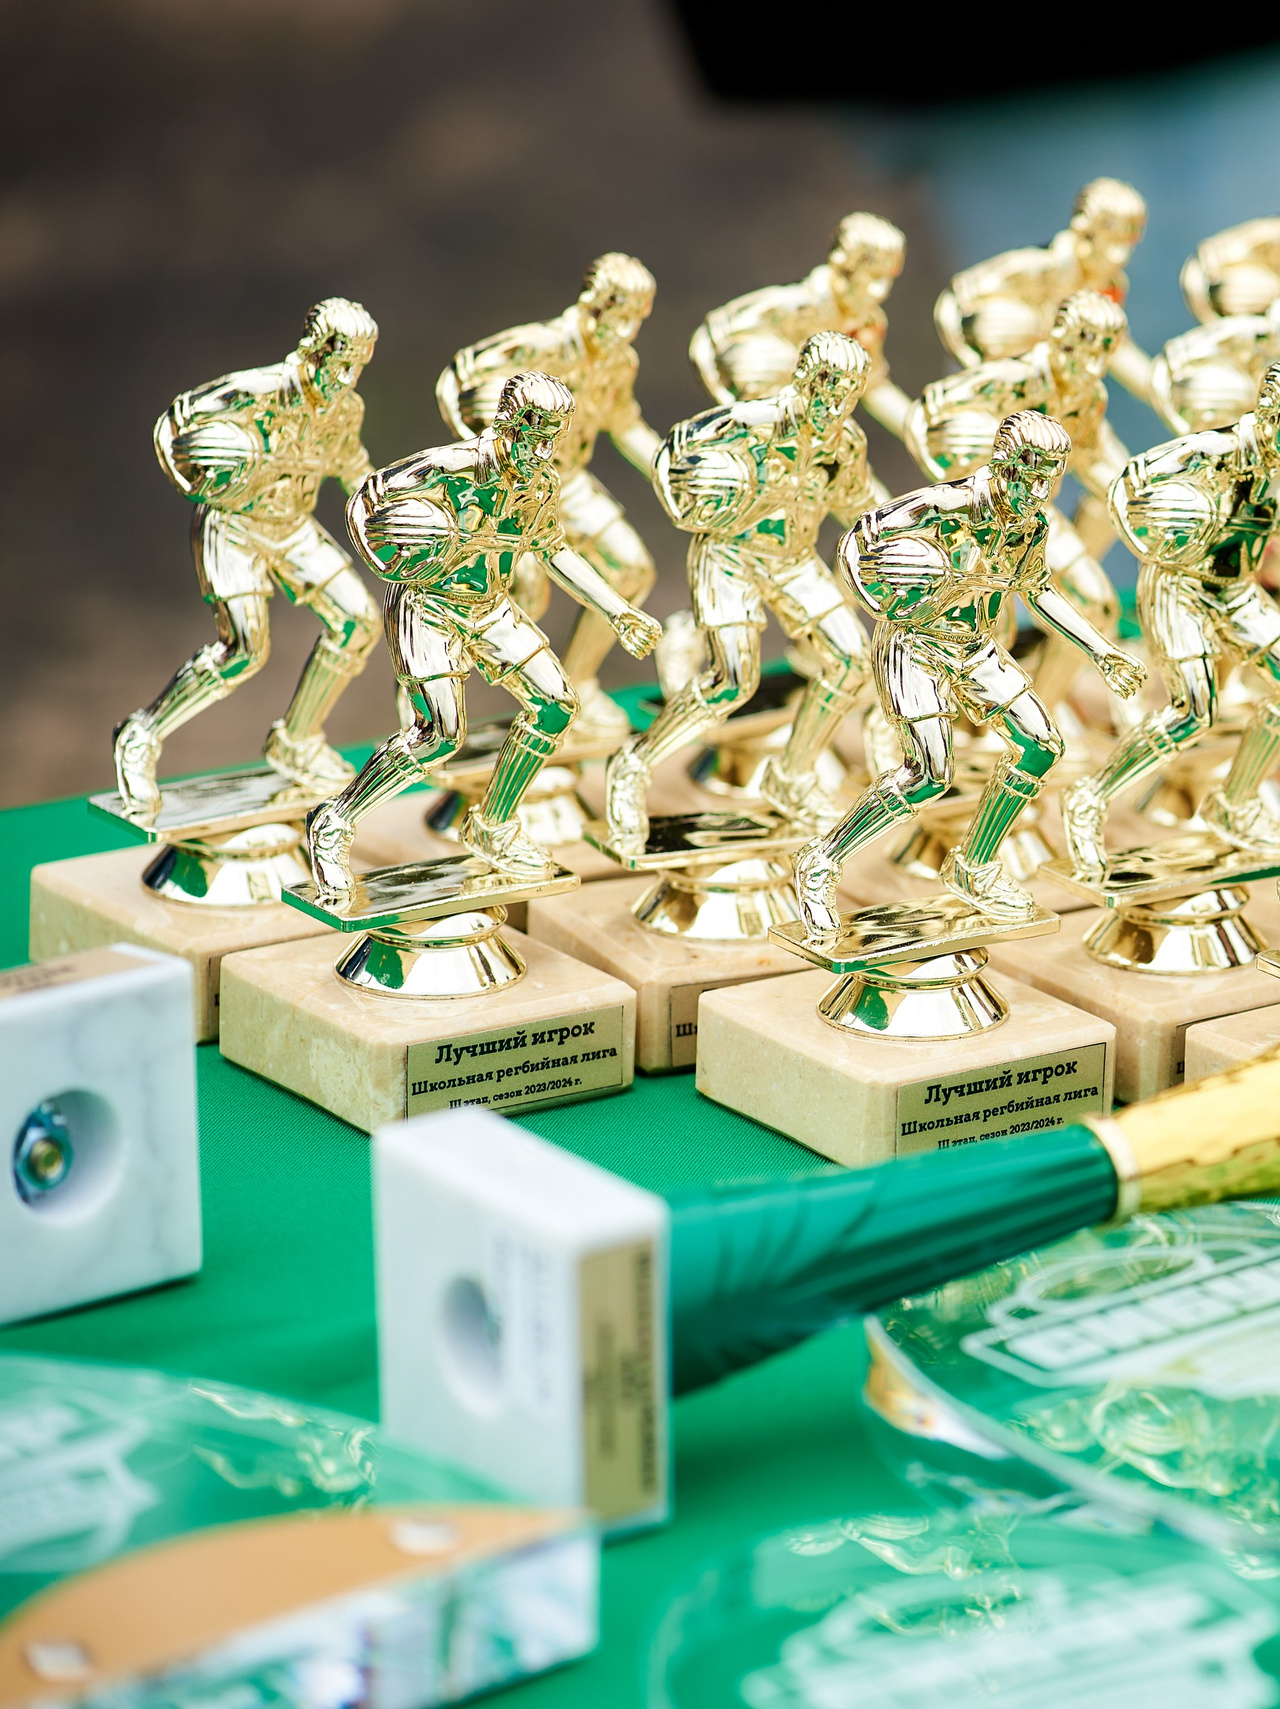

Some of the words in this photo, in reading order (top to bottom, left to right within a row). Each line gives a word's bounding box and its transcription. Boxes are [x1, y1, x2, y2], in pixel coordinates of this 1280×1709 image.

[435, 1030, 527, 1065] Лучший
[532, 1021, 595, 1046] игрок
[411, 1071, 494, 1096] Школьная
[496, 1054, 578, 1082] регбийная
[581, 1047, 618, 1064] лига
[492, 1089, 523, 1101] сезон
[524, 1077, 573, 1095] 2023/2024
[574, 1077, 582, 1086] г.
[924, 1070, 1013, 1105] Лучший
[1016, 1061, 1078, 1085] игрок
[901, 1111, 981, 1136] Школьная
[982, 1096, 1060, 1122] регбийная
[1063, 1086, 1099, 1102] лига
[979, 1128, 1008, 1142] сезон
[1009, 1116, 1055, 1135] 2023/2024
[1057, 1116, 1065, 1125] г.
